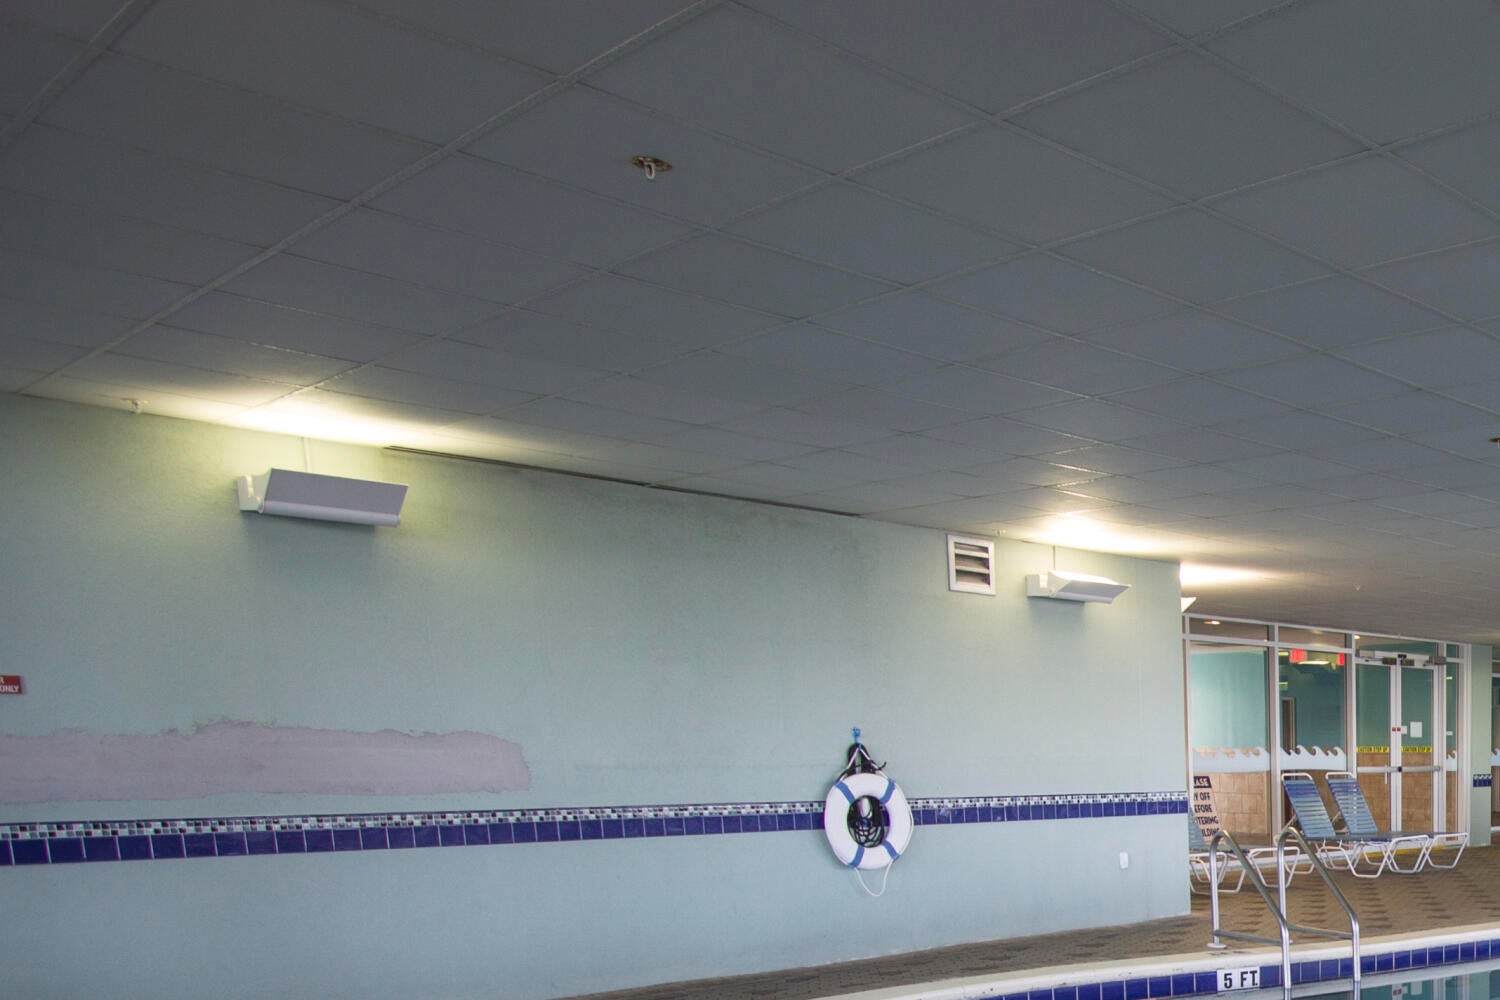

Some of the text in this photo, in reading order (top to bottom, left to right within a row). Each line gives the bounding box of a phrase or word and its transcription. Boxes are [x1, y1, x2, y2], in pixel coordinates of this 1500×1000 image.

[1194, 777, 1209, 786] ASE
[1200, 791, 1210, 801] OFF
[1194, 804, 1213, 813] EFORE
[1197, 816, 1219, 825] TERING
[1223, 970, 1258, 989] 5 FT.
